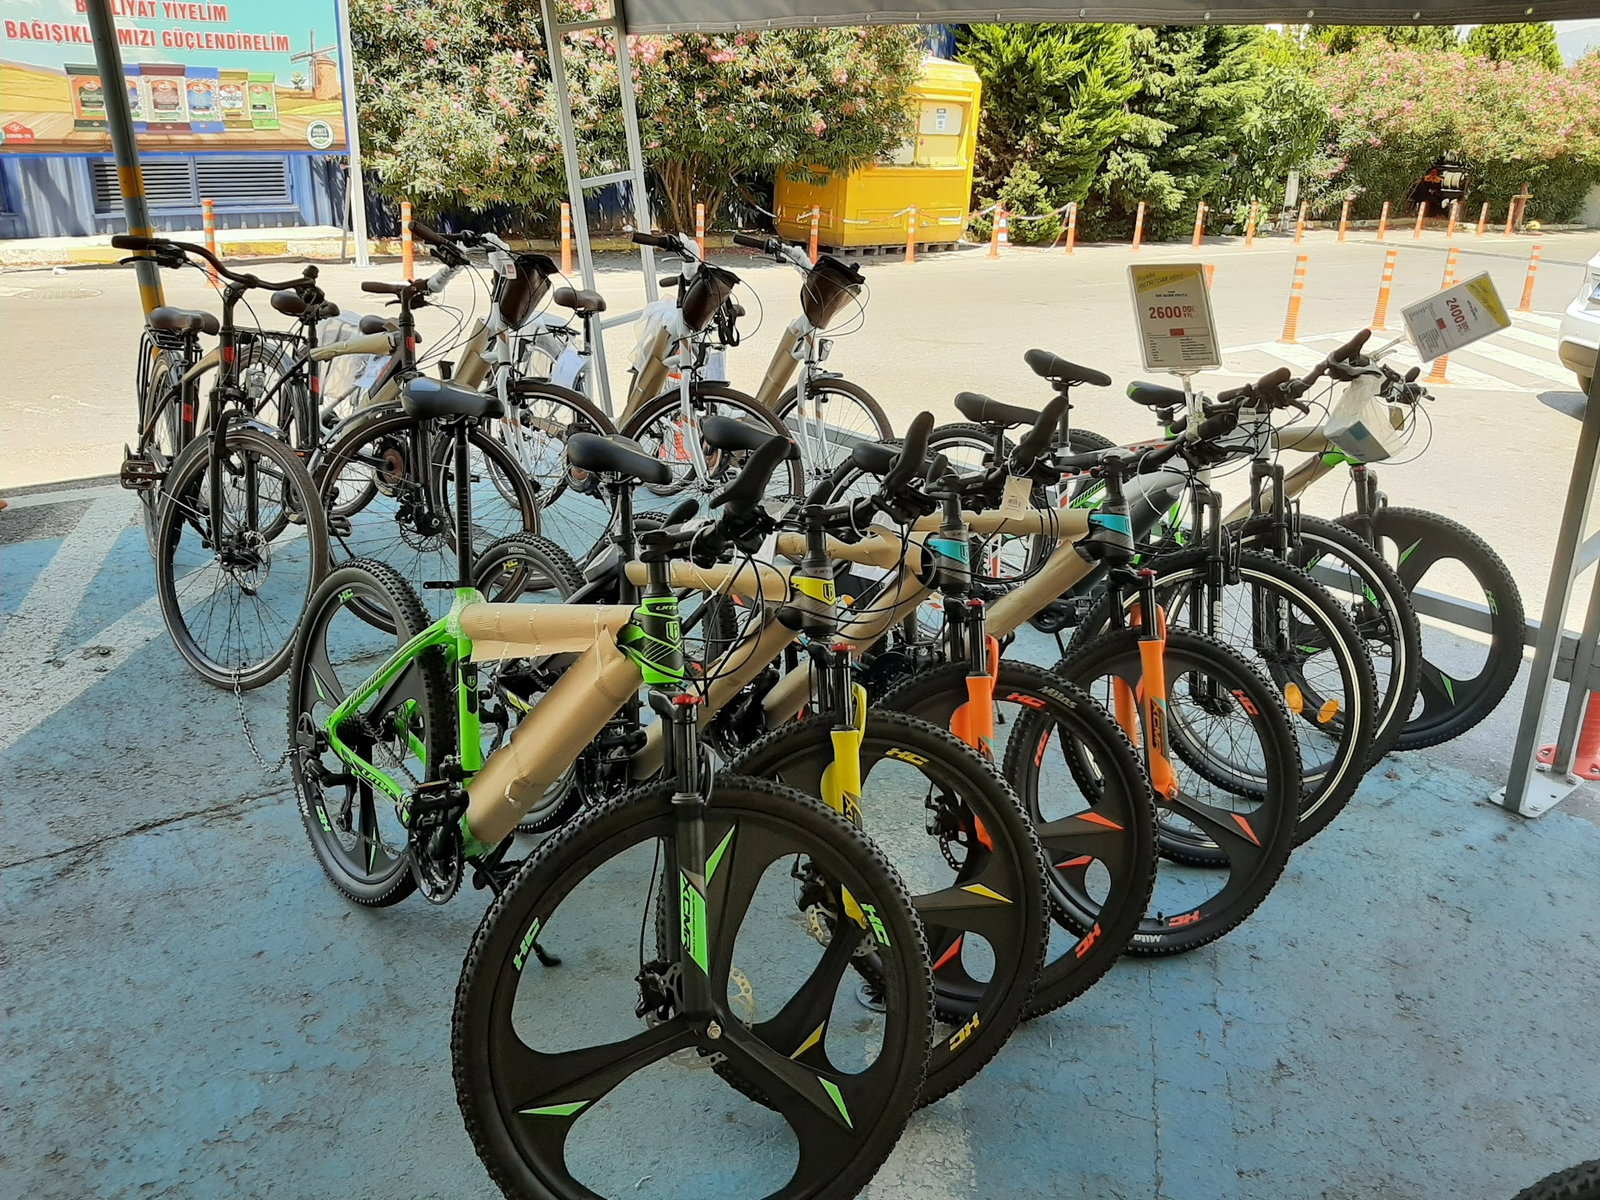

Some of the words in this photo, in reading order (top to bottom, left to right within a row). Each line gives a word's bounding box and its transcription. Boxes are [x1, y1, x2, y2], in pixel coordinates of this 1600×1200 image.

[162, 27, 290, 52] GÜÇLENDİRELİM
[1148, 305, 1181, 319] 2600
[1445, 297, 1465, 324] 2400
[1006, 691, 1047, 709] HC
[885, 747, 930, 766] HC
[859, 903, 892, 948] HC
[513, 916, 541, 971] HC
